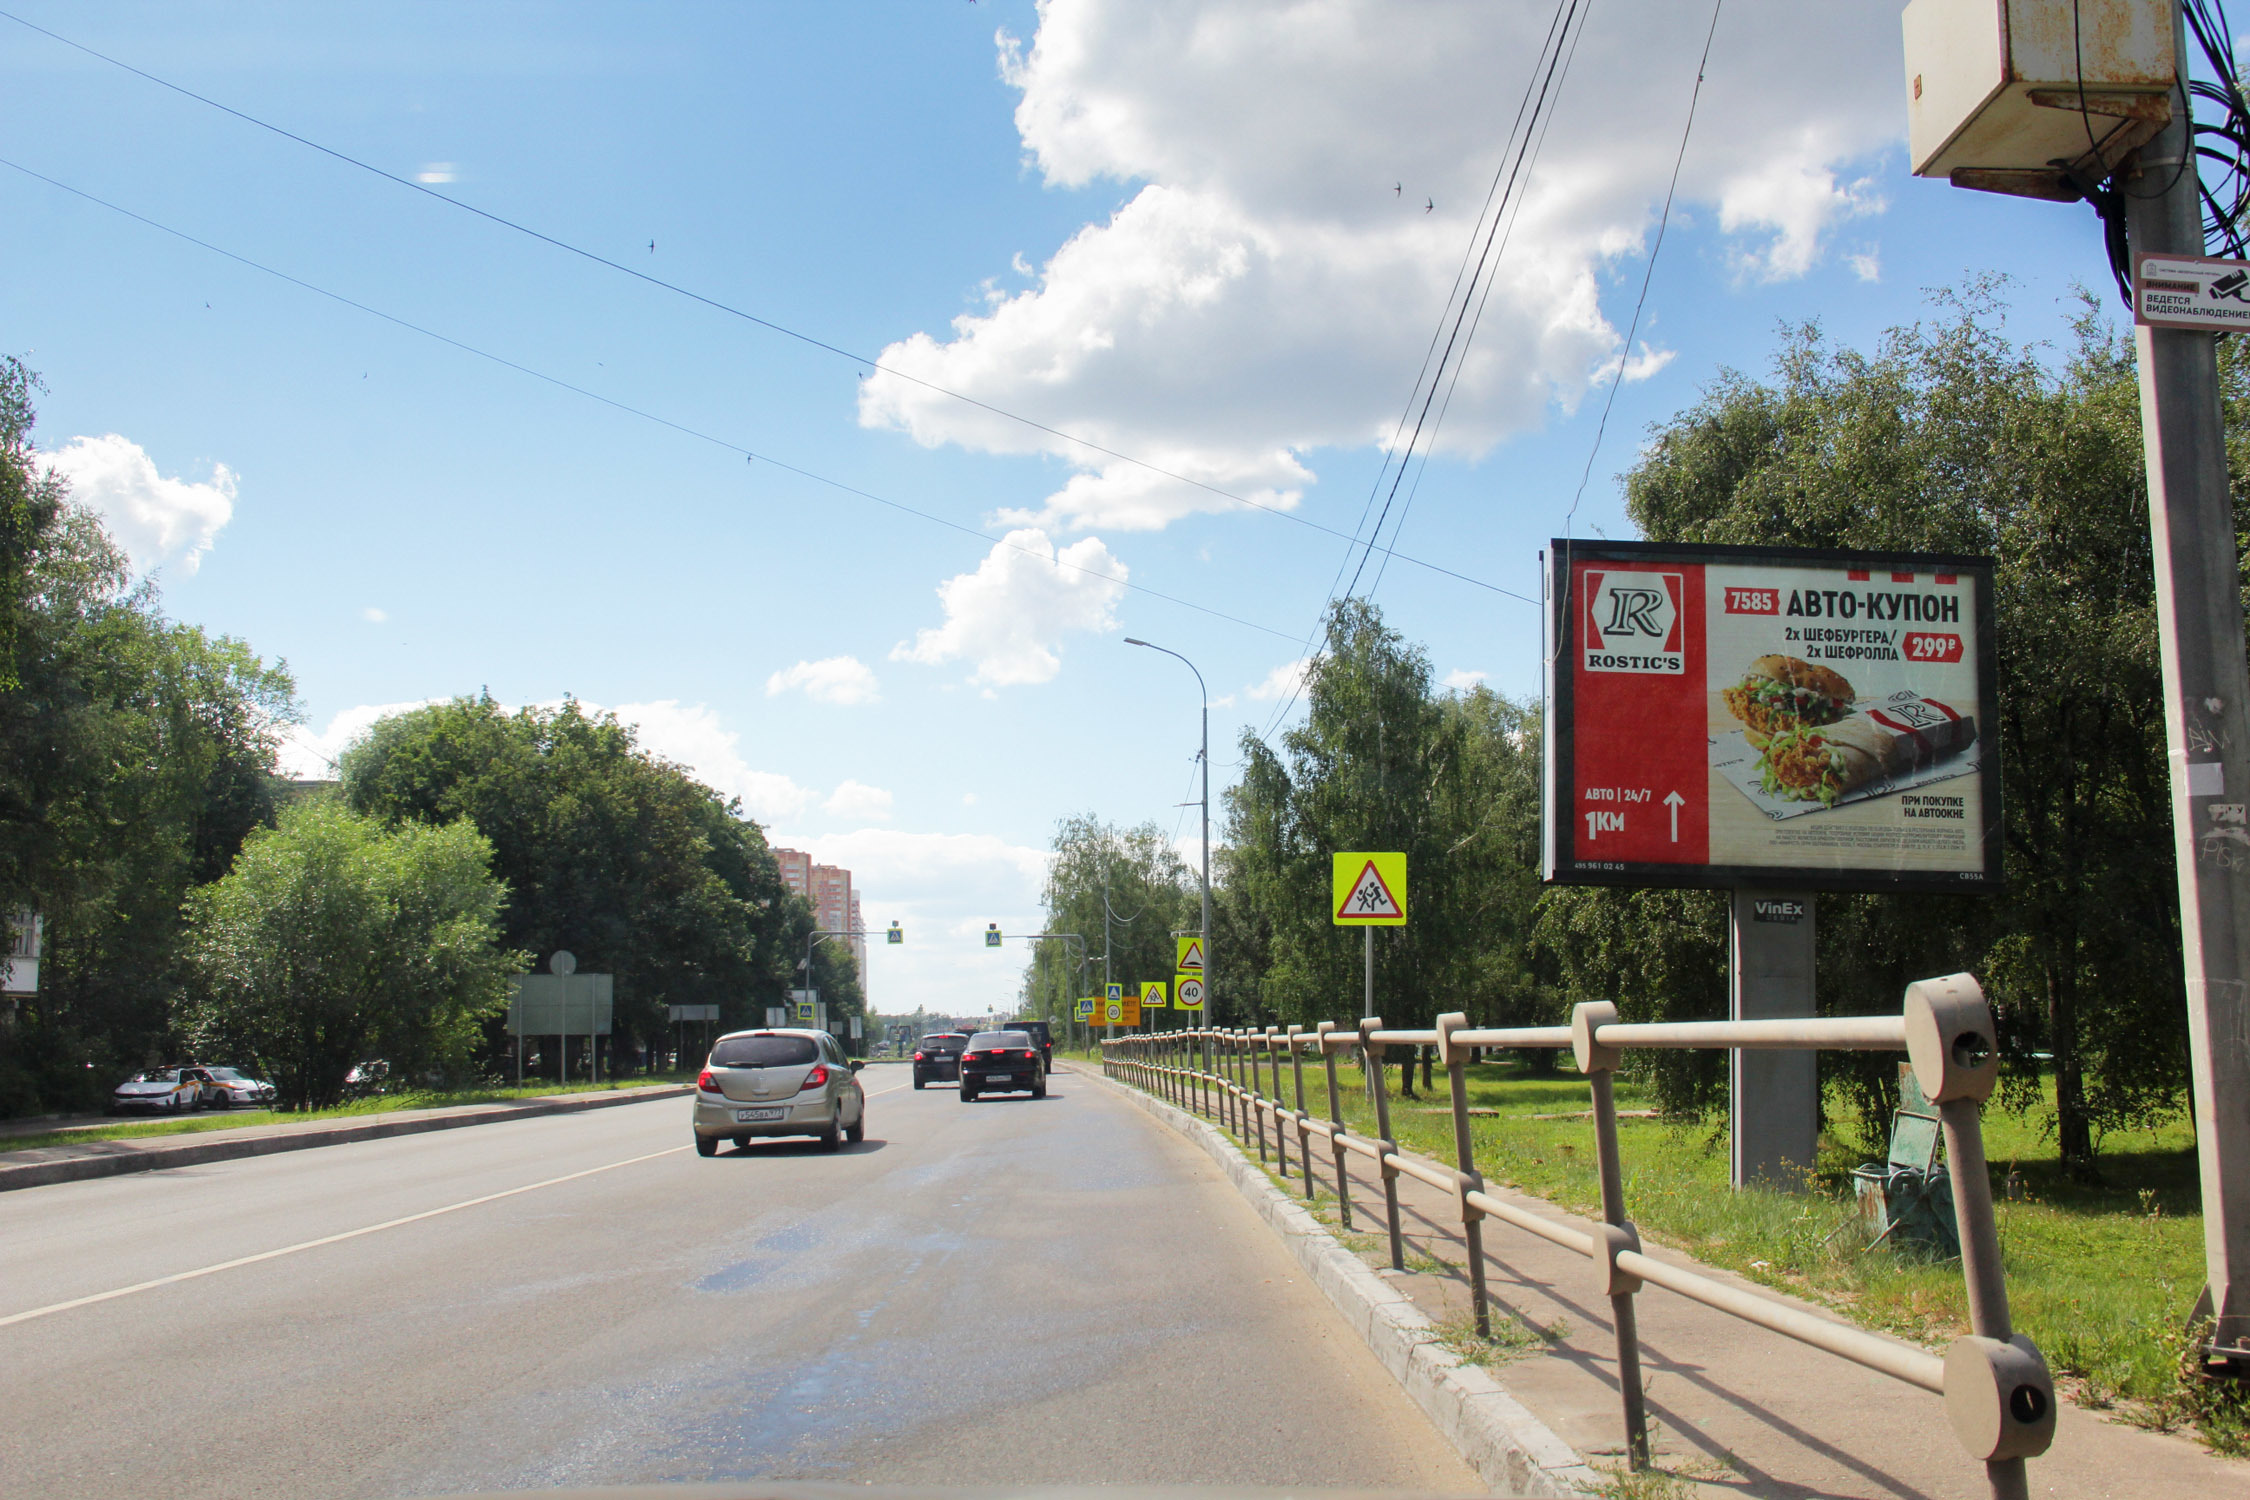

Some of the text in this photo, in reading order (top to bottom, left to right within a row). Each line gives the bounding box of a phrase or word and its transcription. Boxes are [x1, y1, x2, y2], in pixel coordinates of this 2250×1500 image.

[2145, 281, 2196, 291] ВНИМАНИЕ
[2146, 294, 2191, 305] ВЕДЕТСЯ
[2145, 304, 2250, 319] ВИДЕОНАБЛЮДЕНИЕ
[1731, 591, 1772, 610] 7585
[1786, 589, 1960, 623] АВТО-КУПОН
[1803, 627, 1898, 646] ШЕФБУРГЕРА/
[1824, 645, 1899, 661] ШЕФРОЛЛА
[1588, 654, 1680, 670] ROSTIC'S
[1584, 788, 1651, 803] АВТО 24/7
[1901, 795, 1964, 807] ПРИ ПОКУПКЕ
[1904, 808, 1964, 819] НА АВТООКНЕ
[1587, 862, 1601, 870] 961
[1615, 863, 1625, 871] 45
[1755, 902, 1803, 915] VinEx
[1184, 987, 1199, 997] 40
[1110, 1008, 1118, 1016] 20
